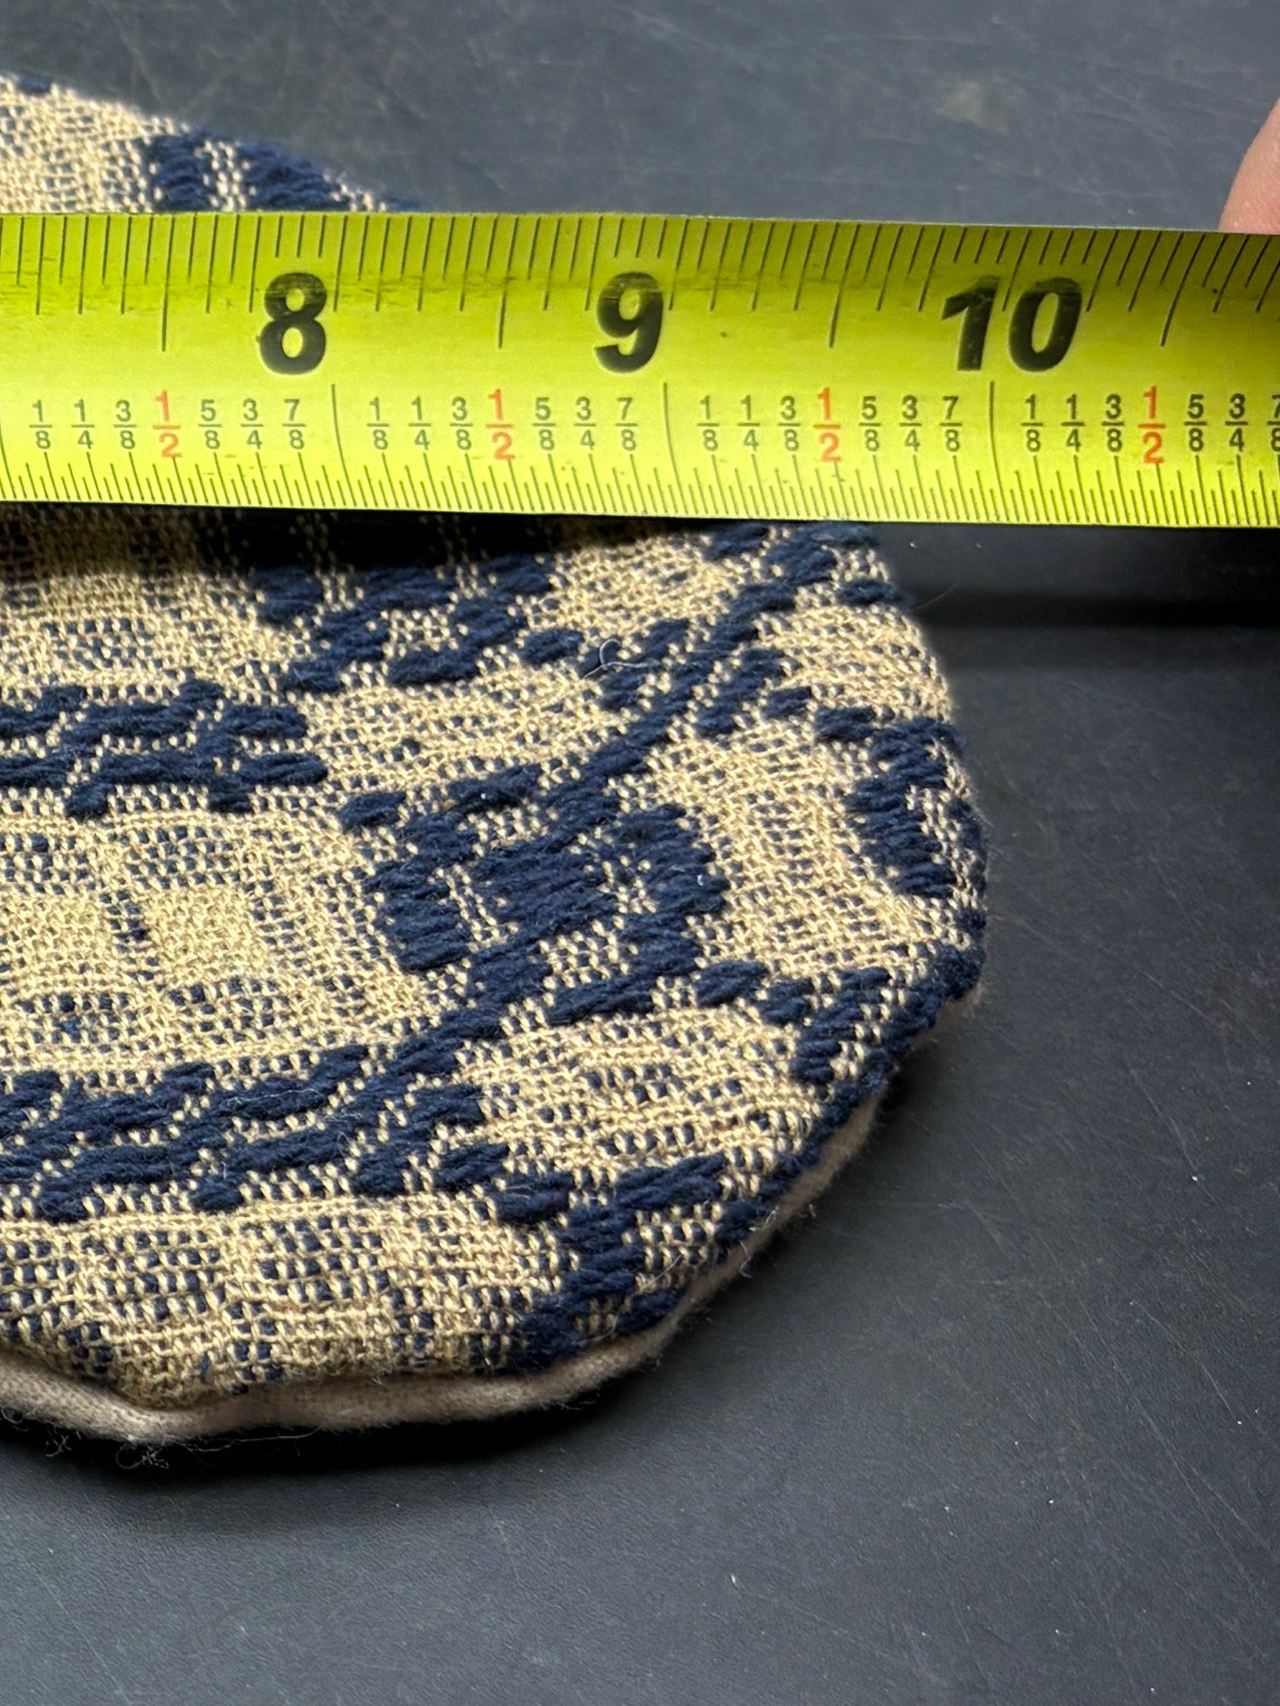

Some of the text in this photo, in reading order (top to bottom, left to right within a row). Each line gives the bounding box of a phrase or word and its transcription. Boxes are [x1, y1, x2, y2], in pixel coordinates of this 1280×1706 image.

[258, 271, 328, 376] 8
[594, 271, 665, 374] 9
[941, 275, 1083, 373] 10
